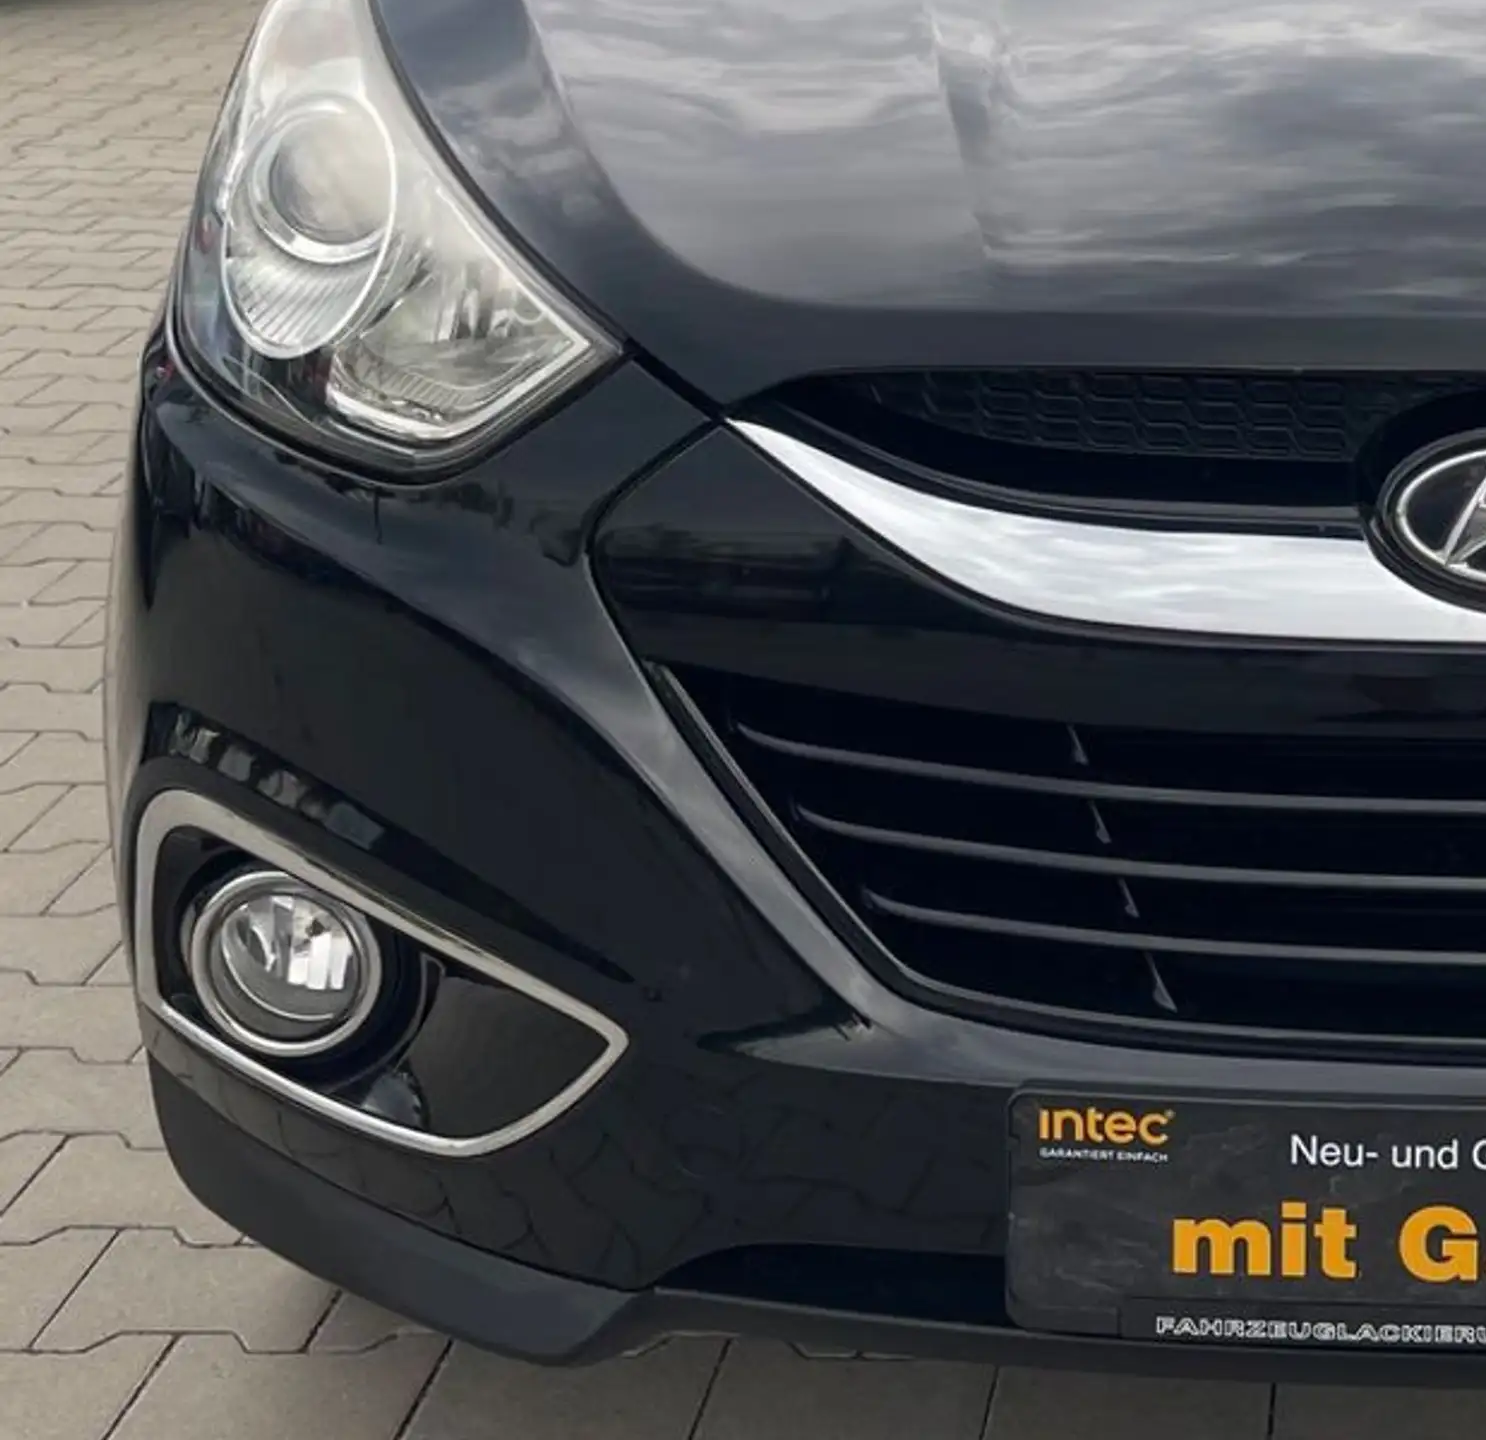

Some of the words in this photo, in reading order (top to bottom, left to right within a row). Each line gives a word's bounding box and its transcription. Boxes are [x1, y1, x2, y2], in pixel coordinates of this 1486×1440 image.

[1039, 1147, 1114, 1160] GARANTIERT
[1117, 1151, 1168, 1163] EINFACH
[1290, 1134, 1378, 1167] Neu-
[1391, 1139, 1459, 1169] und
[1173, 1201, 1357, 1278] mit
